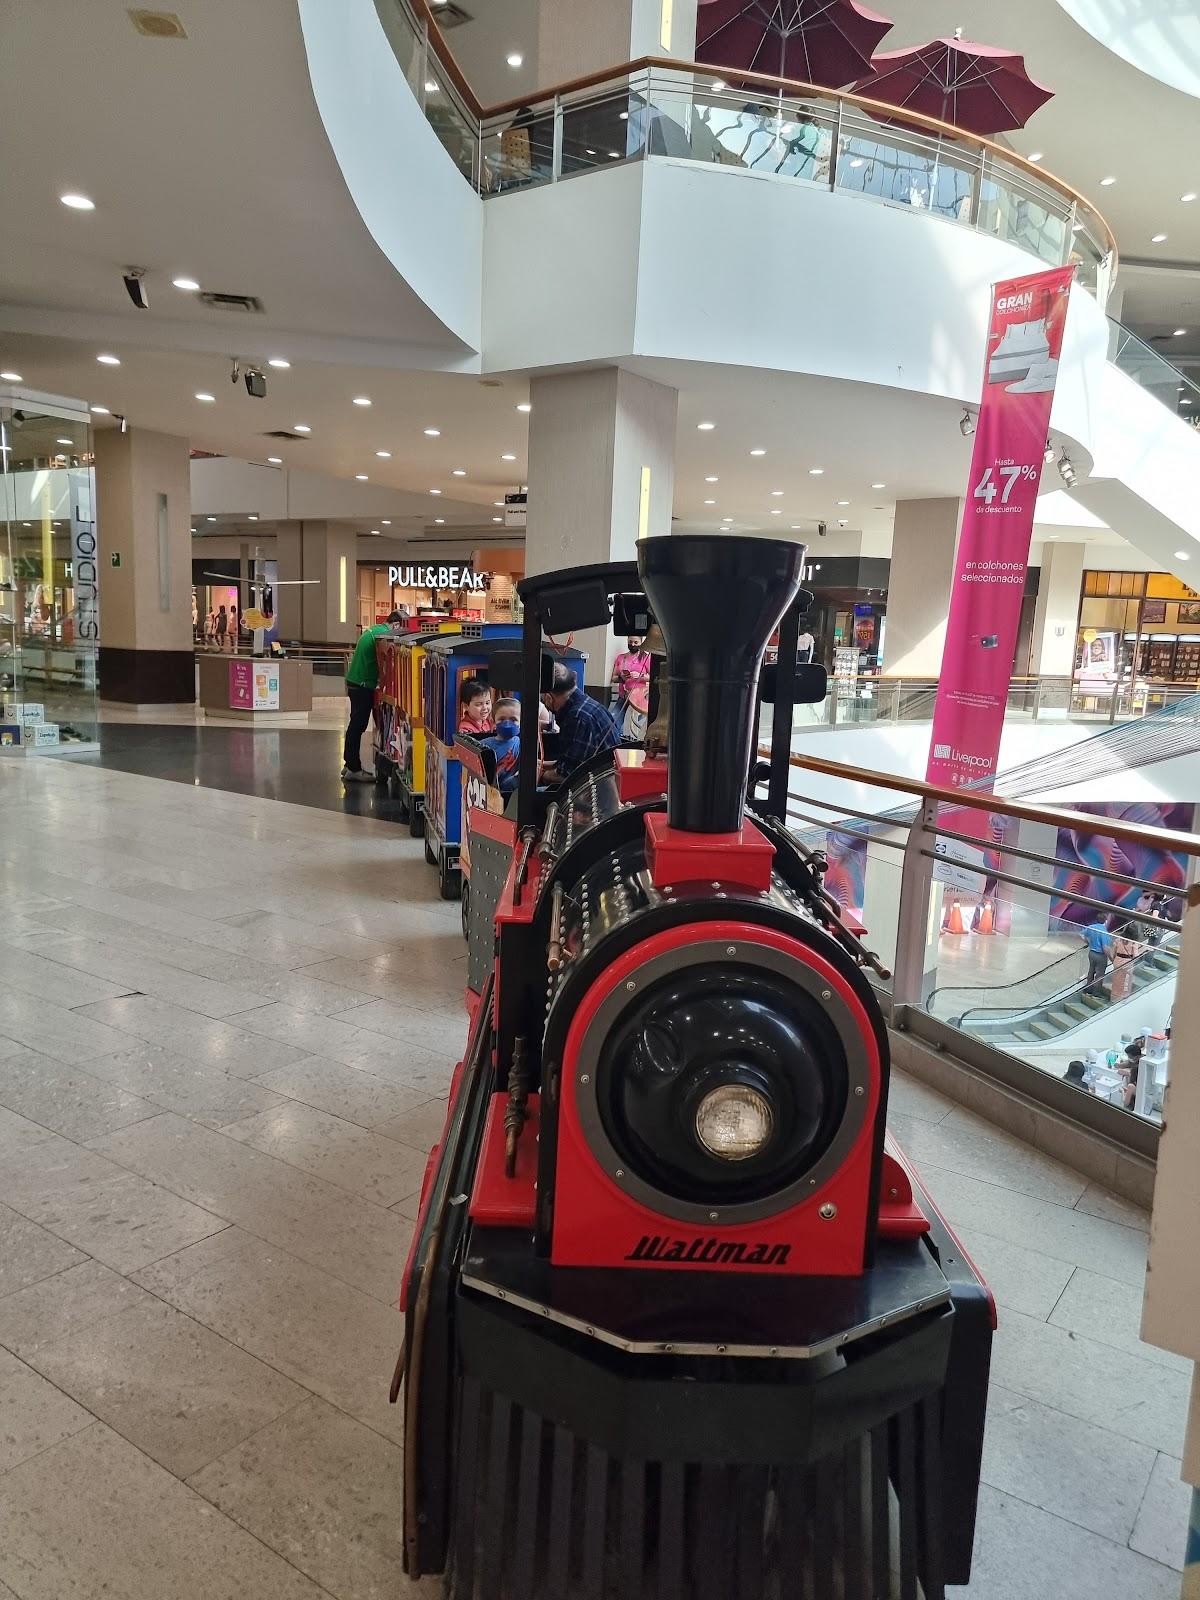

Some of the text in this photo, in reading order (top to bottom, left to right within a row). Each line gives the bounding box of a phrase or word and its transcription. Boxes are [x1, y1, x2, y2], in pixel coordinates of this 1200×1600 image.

[997, 291, 1033, 310] GRAN
[973, 464, 1037, 505] 47%
[976, 505, 1022, 514] de descuento
[965, 560, 1024, 571] en colchones
[76, 531, 99, 640] STUDIO
[388, 565, 485, 589] PULL&BEAR
[961, 572, 1024, 584] seleccionados
[951, 748, 993, 769] Liverpool
[624, 1235, 792, 1265] Wattman
